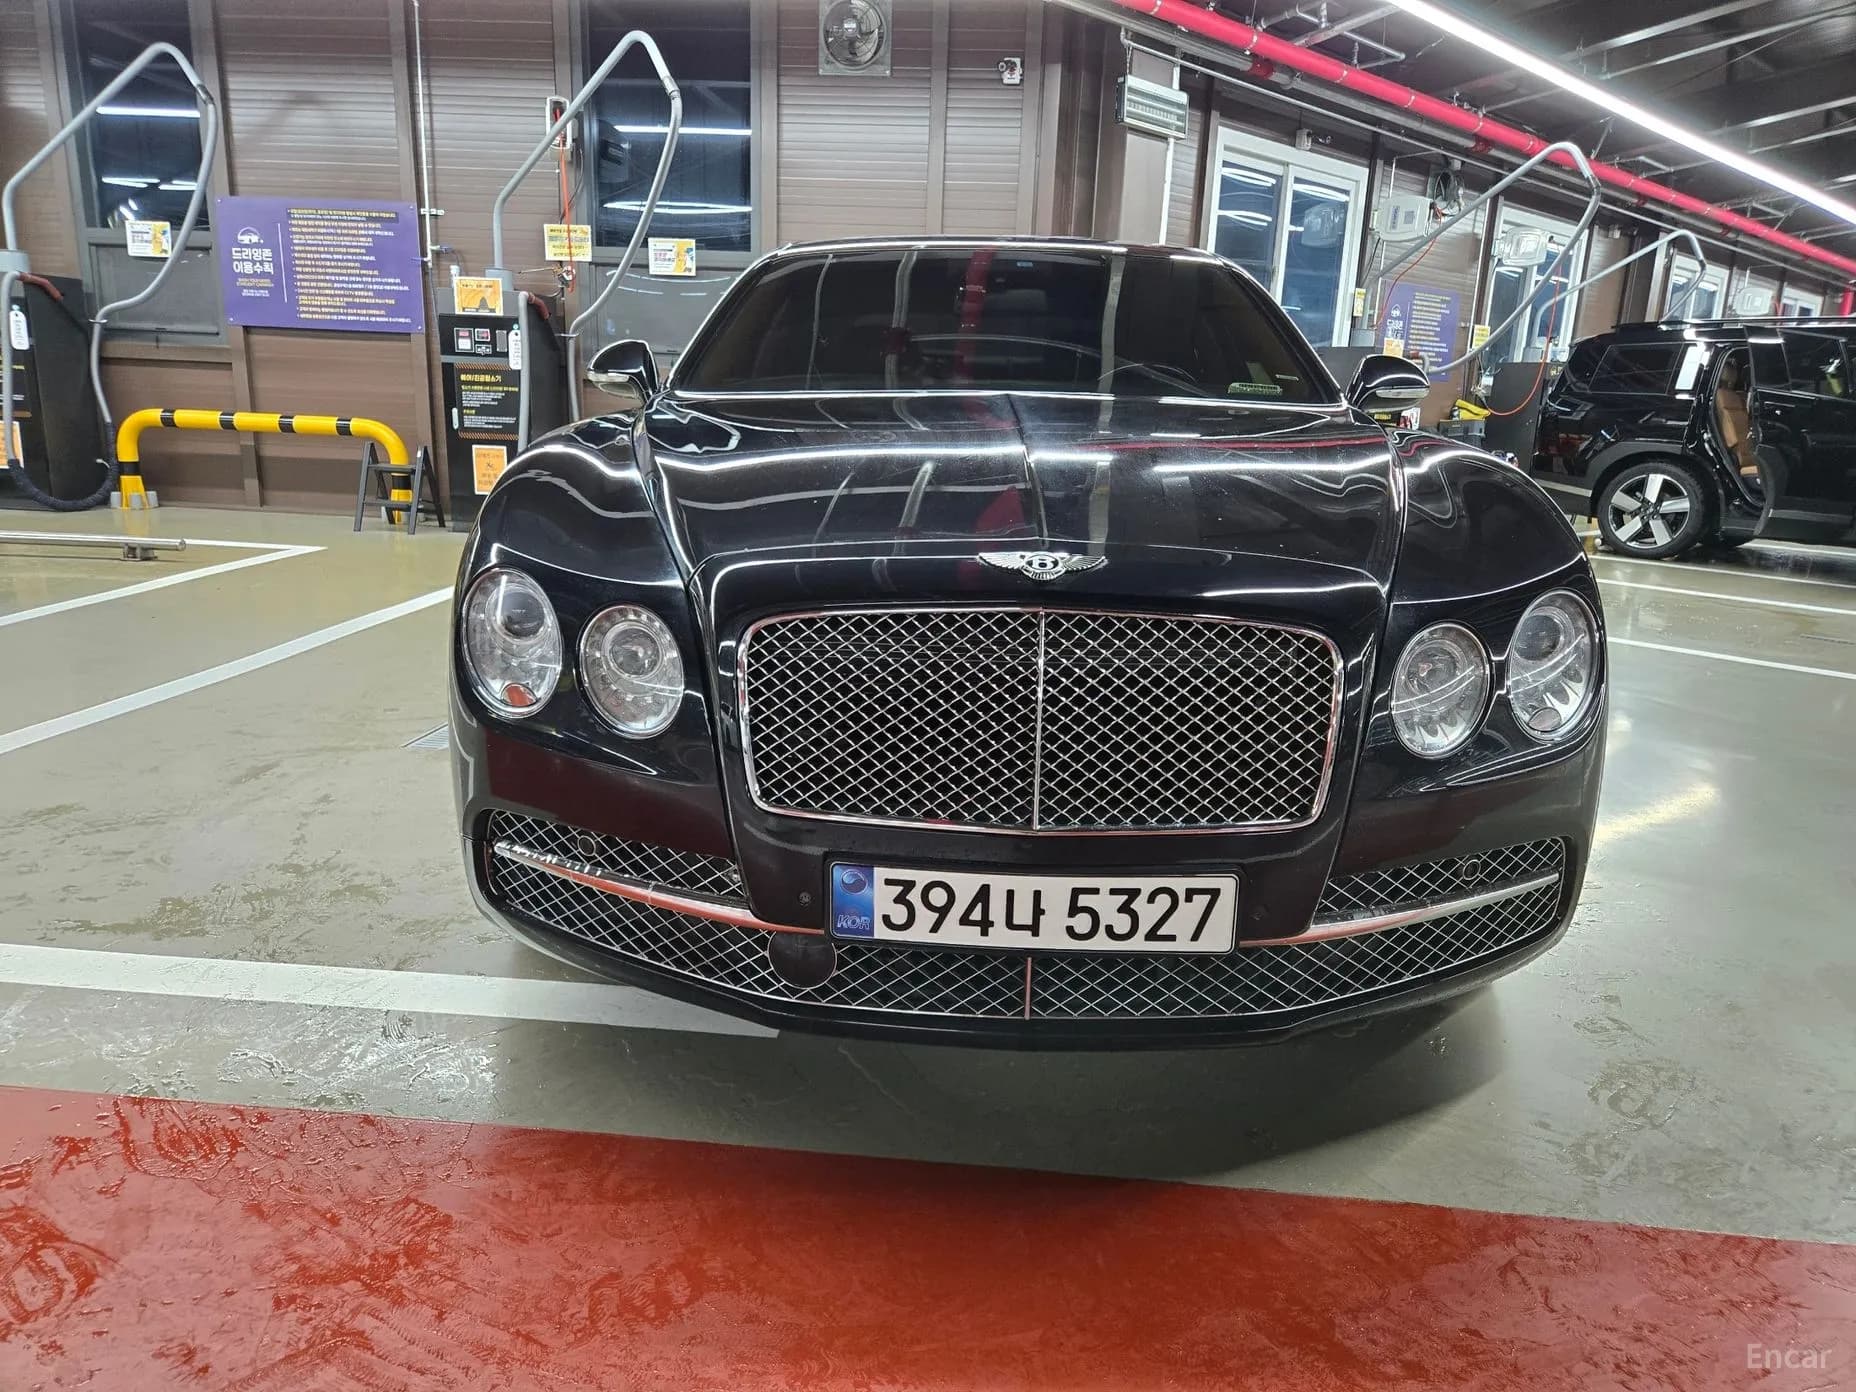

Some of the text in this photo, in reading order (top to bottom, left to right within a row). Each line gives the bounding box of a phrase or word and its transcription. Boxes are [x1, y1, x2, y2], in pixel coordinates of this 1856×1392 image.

[233, 261, 274, 275] 이용수칙
[881, 878, 1222, 942] 394나 5327
[837, 914, 871, 930] KOR
